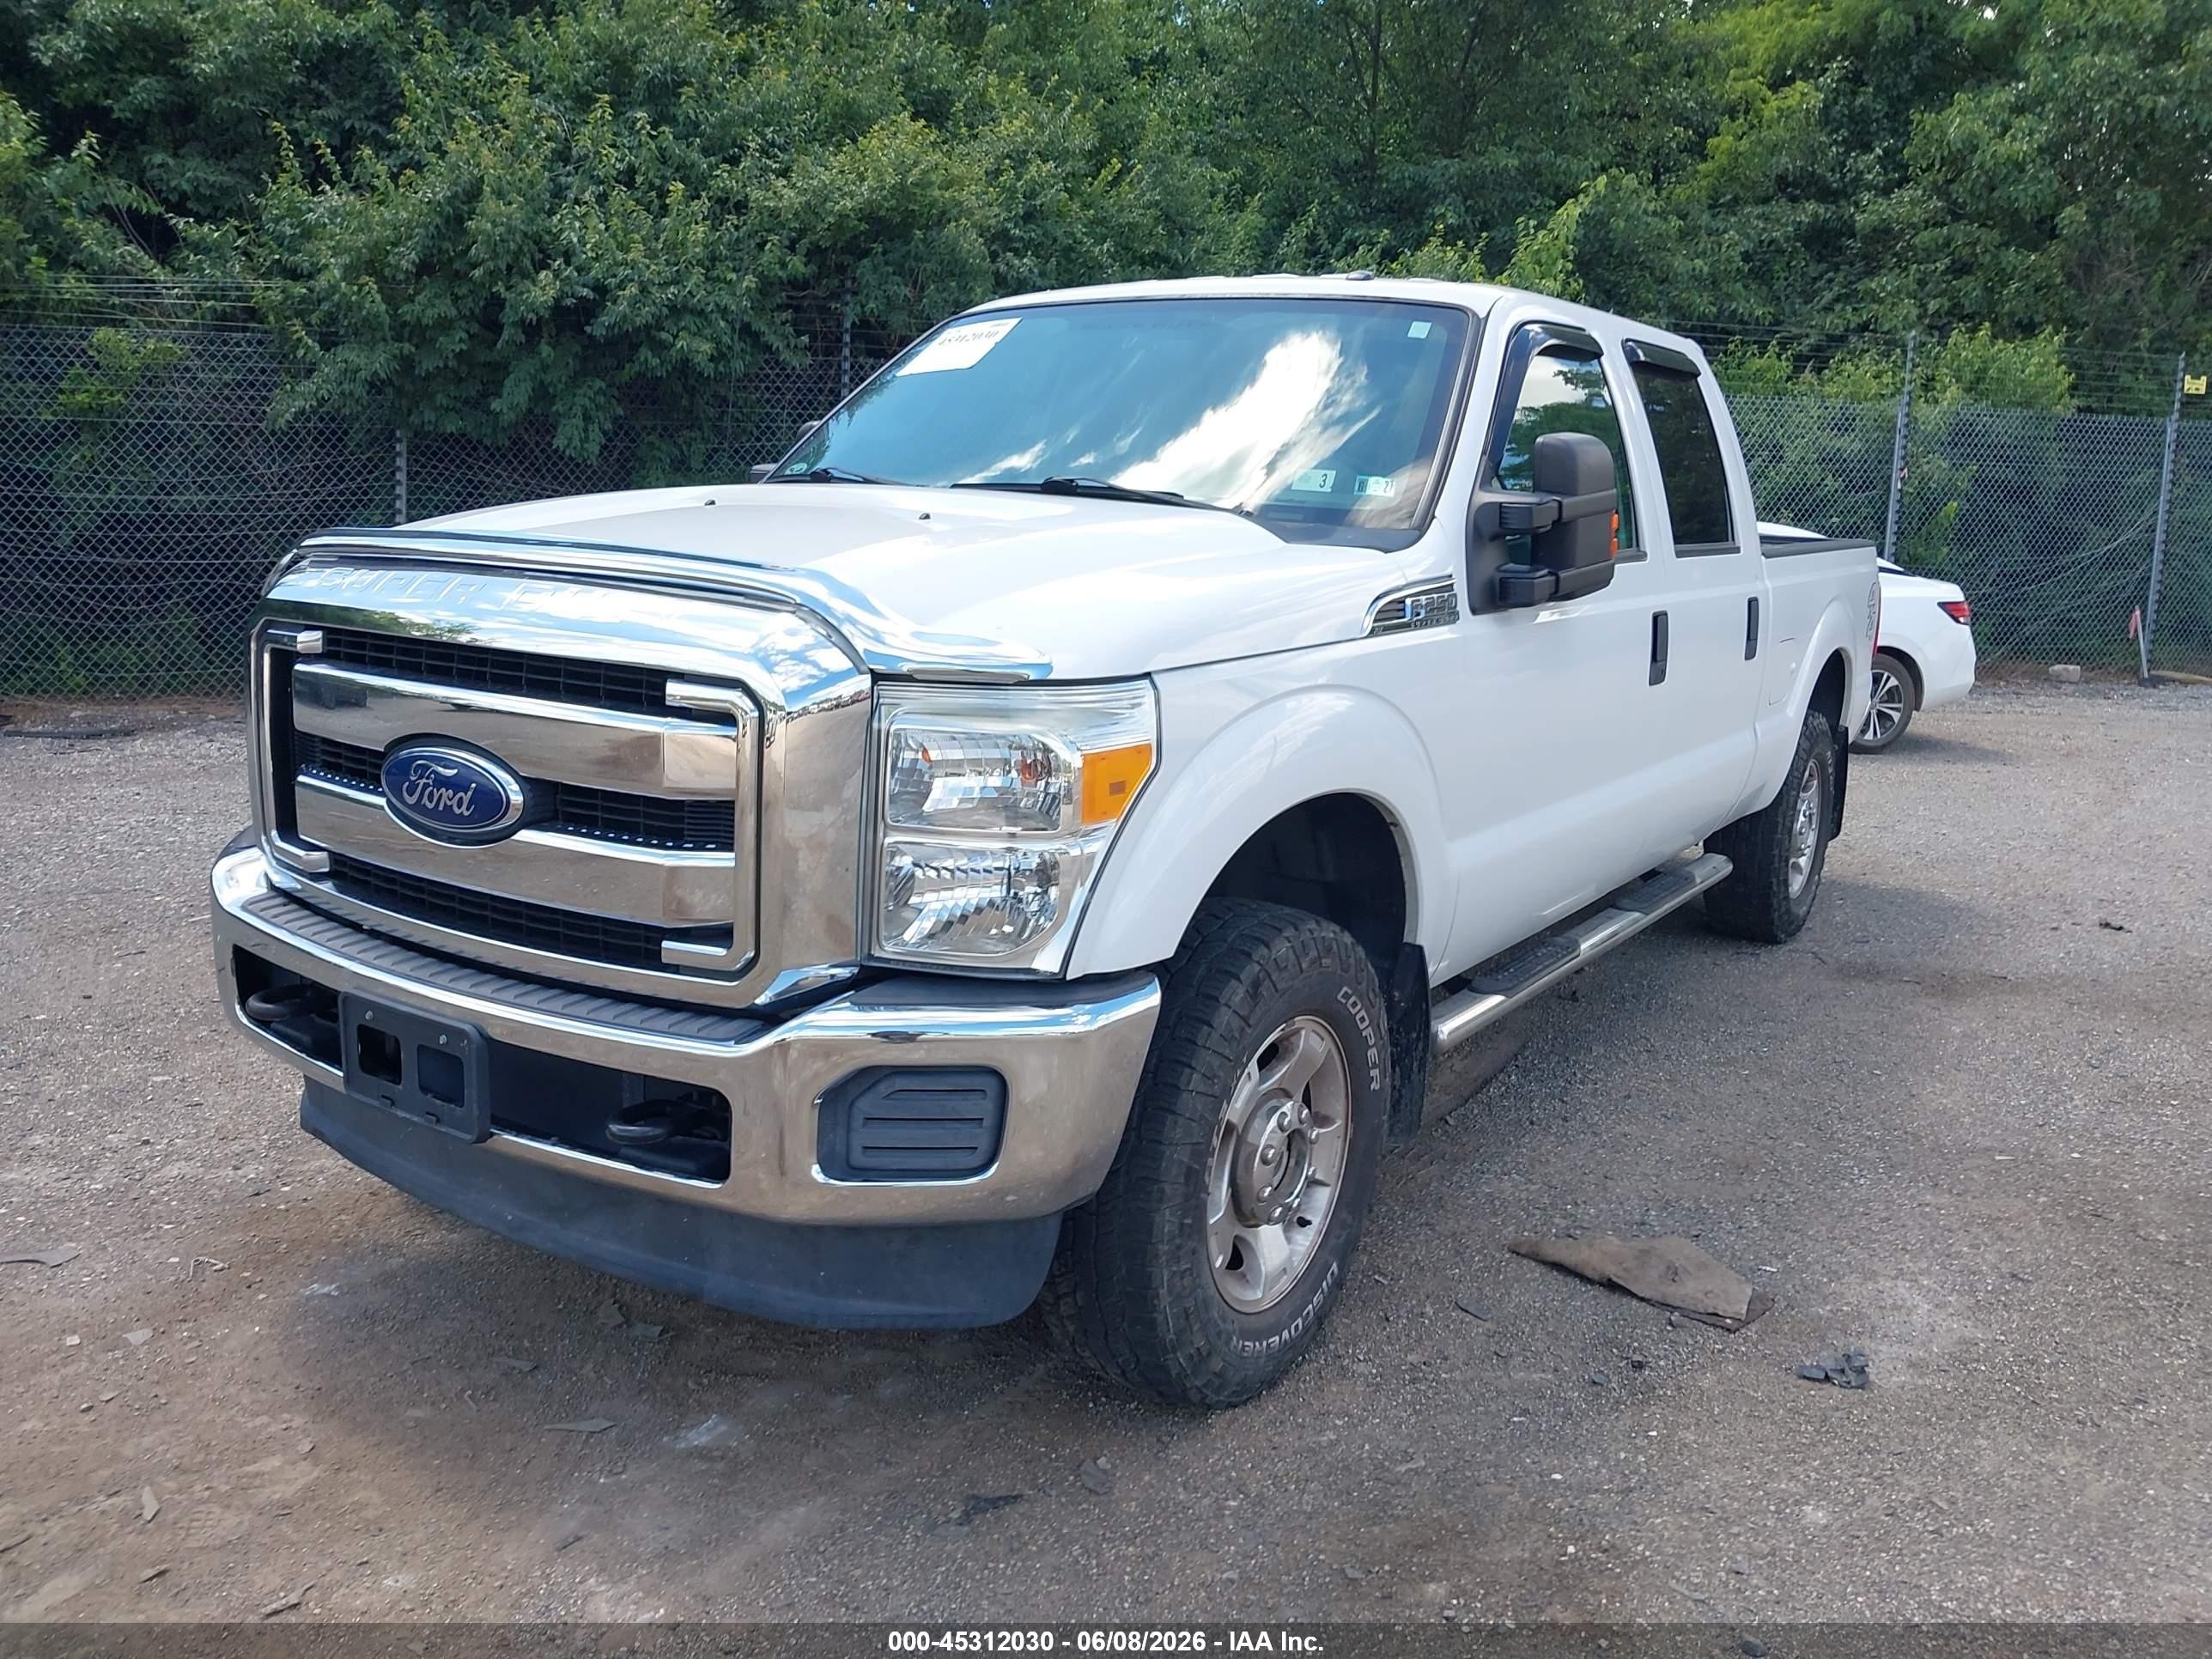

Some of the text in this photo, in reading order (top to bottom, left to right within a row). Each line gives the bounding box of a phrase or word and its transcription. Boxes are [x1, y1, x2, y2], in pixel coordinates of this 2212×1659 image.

[1319, 473, 1328, 489] 3
[402, 760, 477, 816] Ford
[1337, 986, 1381, 1091] COOPER
[1230, 1260, 1339, 1357] DISCOVERER
